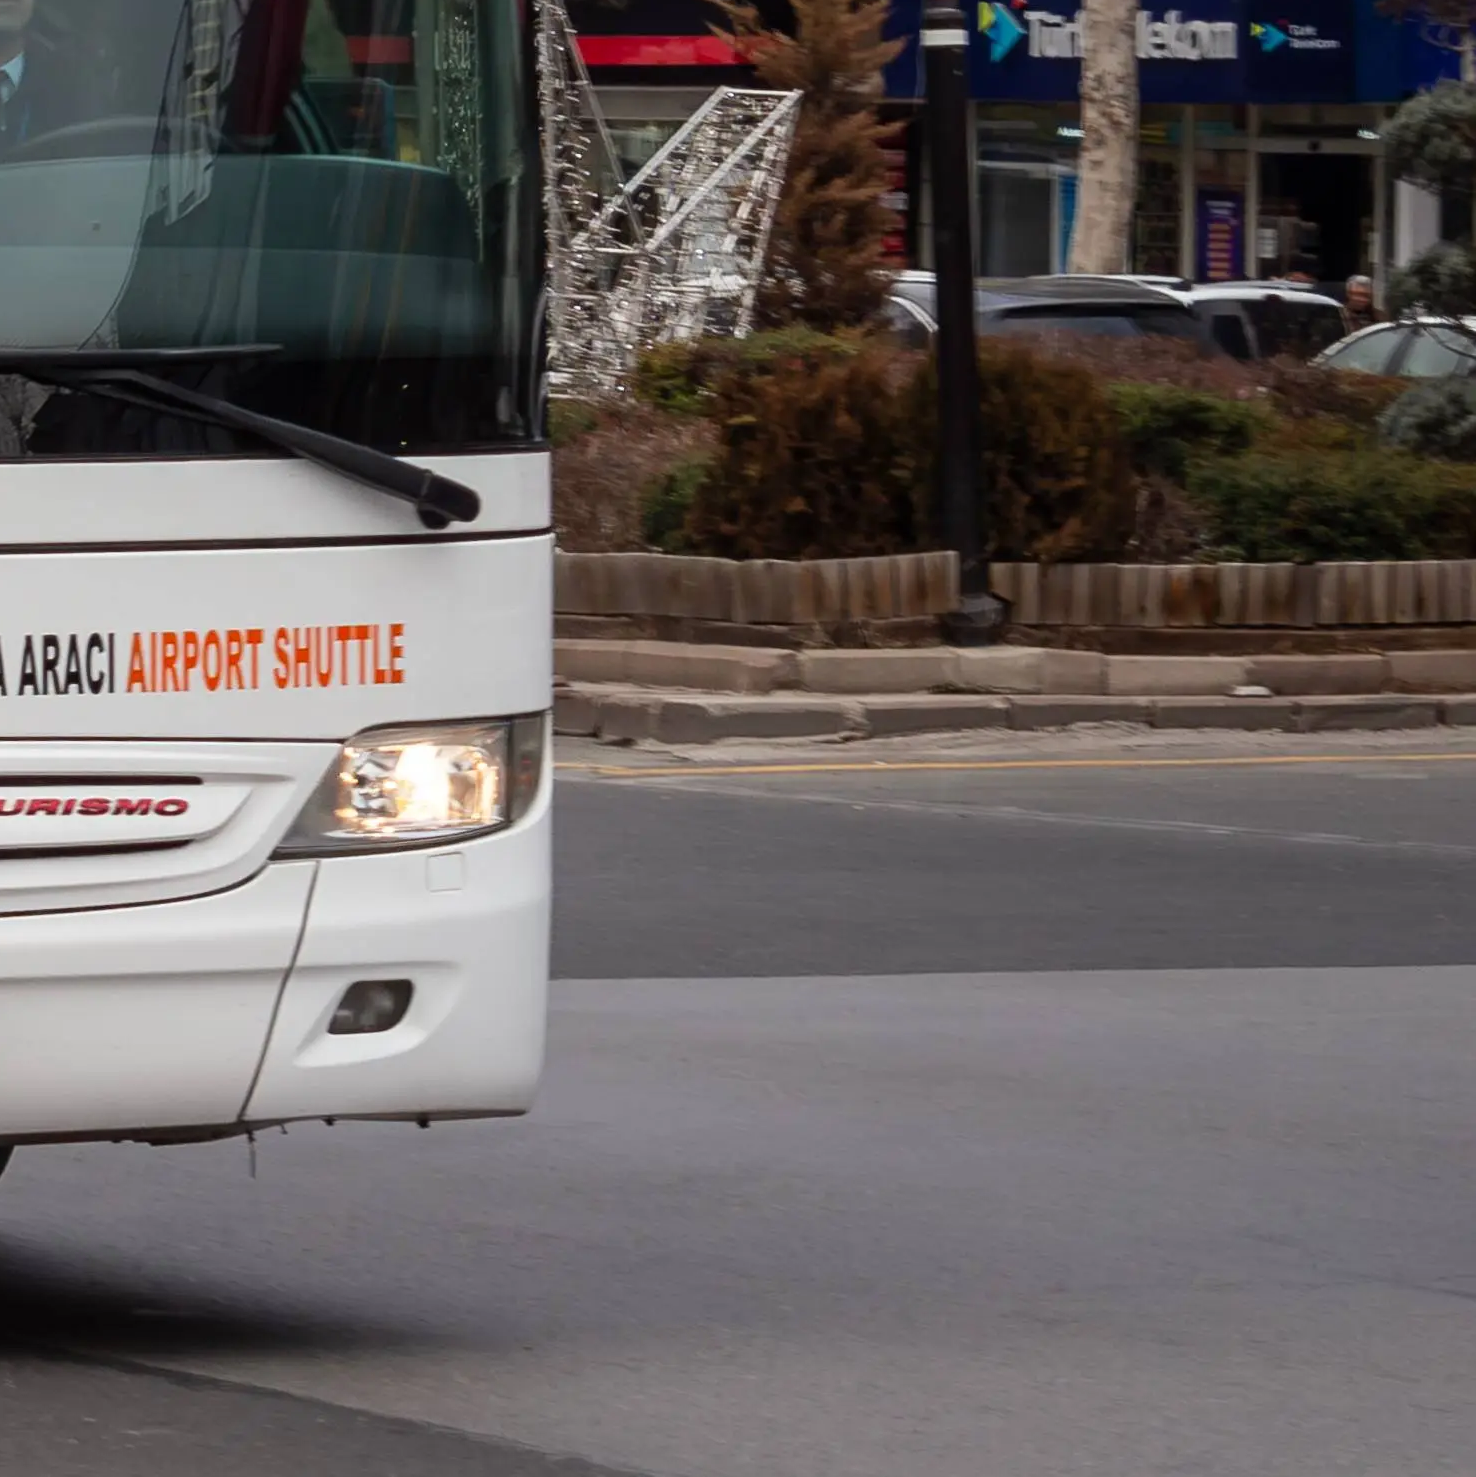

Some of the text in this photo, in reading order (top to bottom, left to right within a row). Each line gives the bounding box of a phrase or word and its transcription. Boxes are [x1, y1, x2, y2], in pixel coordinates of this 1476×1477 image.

[17, 632, 116, 697] ARACI
[125, 628, 264, 694] AIRPORT
[271, 623, 406, 690] SHUTTLE
